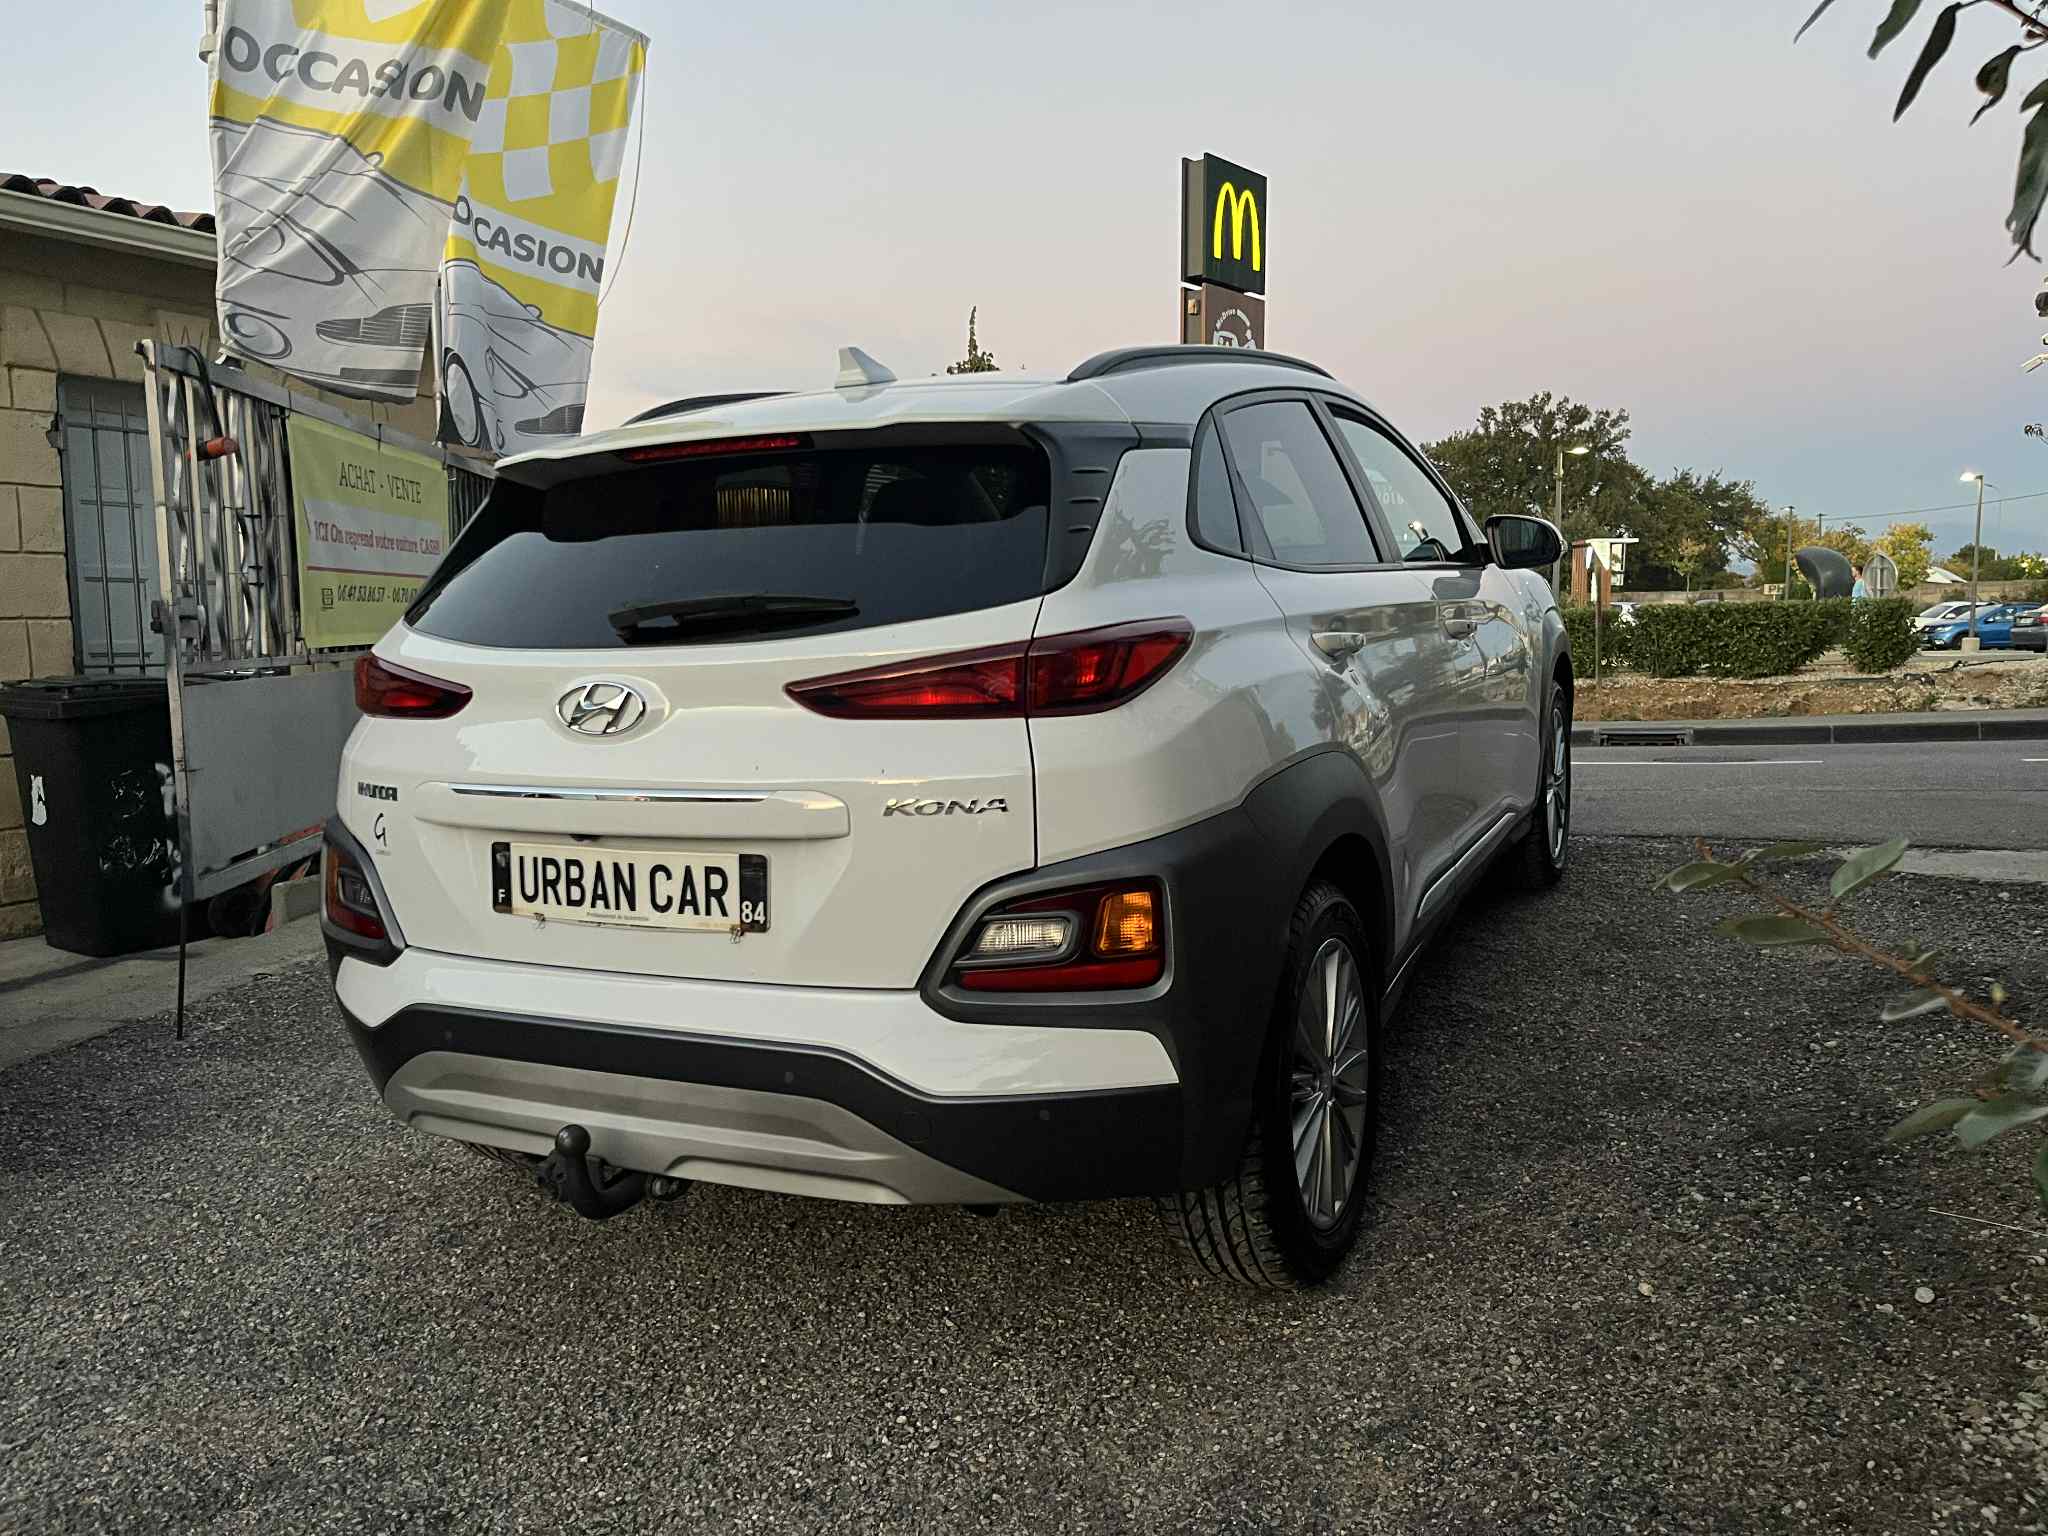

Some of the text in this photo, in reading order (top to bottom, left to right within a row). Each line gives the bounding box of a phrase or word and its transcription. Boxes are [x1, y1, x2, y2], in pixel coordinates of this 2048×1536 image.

[453, 195, 604, 283] OCASION
[339, 462, 376, 493] ACHAT
[386, 474, 421, 504] VENTE
[882, 798, 1009, 817] KONA
[498, 888, 506, 903] F
[518, 855, 729, 918] URBAN CAR
[741, 900, 766, 925] 84
